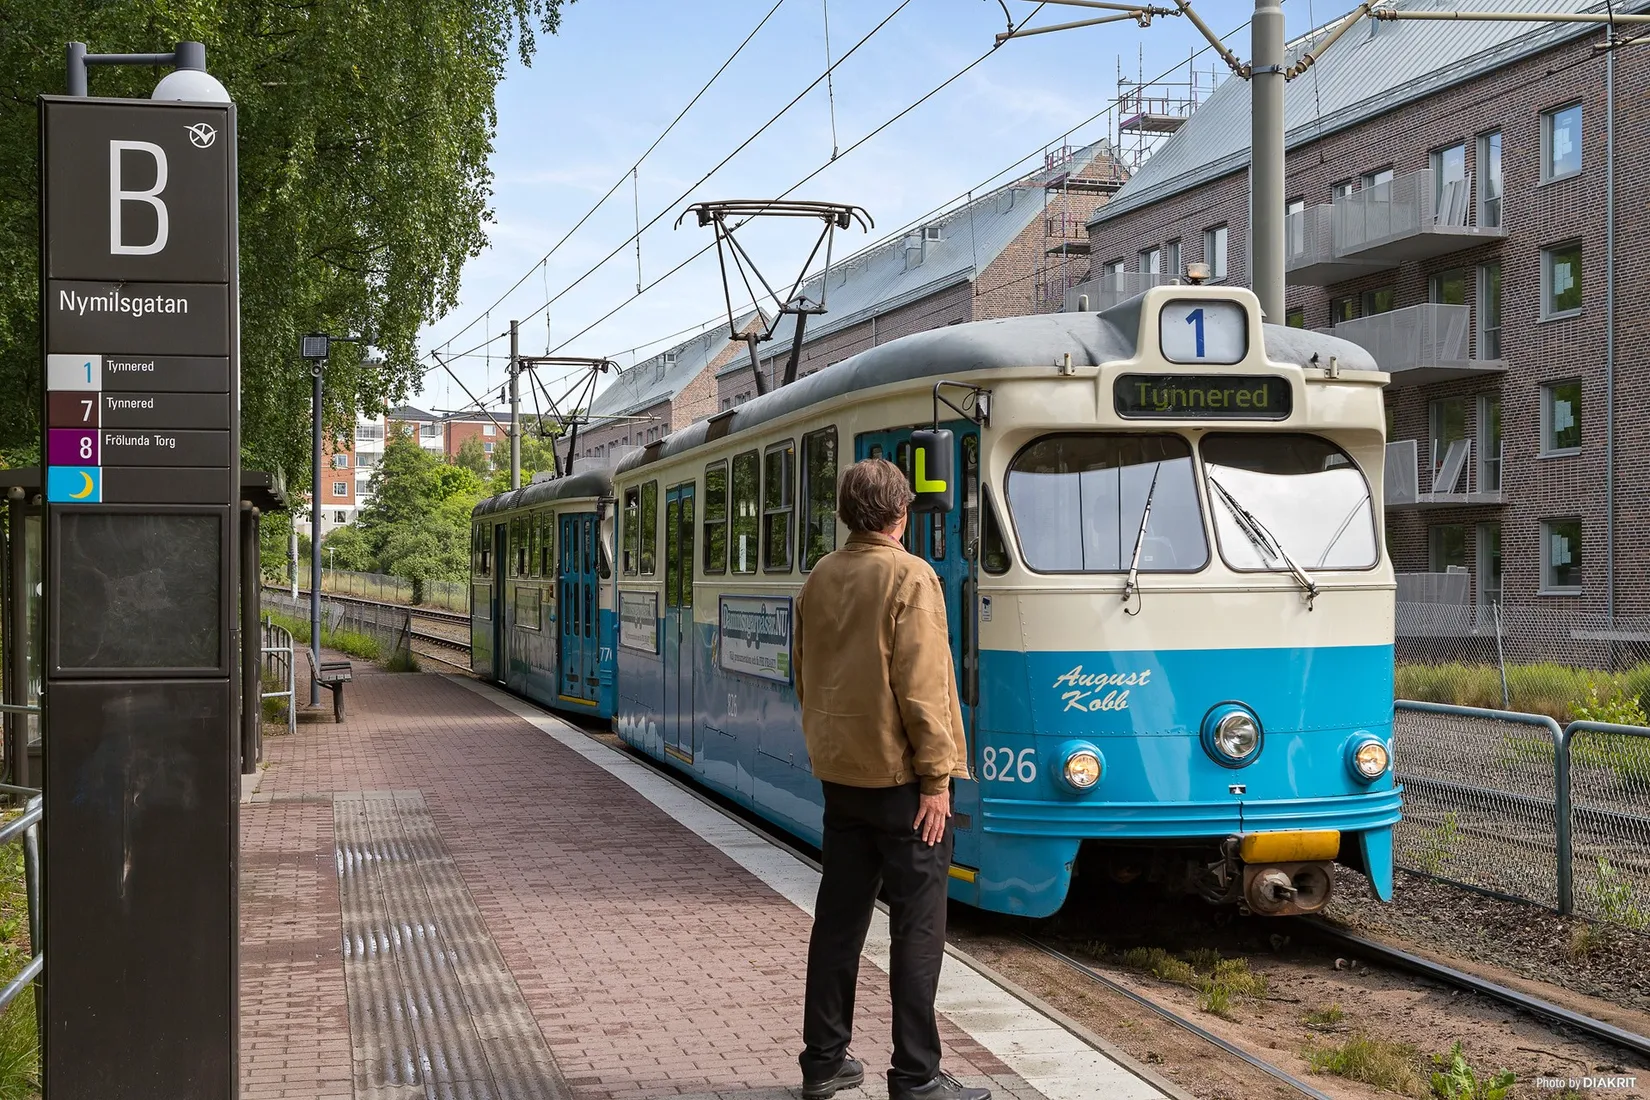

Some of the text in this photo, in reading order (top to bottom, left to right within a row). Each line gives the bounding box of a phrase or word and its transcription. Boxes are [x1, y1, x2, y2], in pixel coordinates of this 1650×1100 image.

[110, 140, 169, 255] B
[59, 290, 188, 317] Nymilsgatan
[1185, 308, 1205, 358] 1
[83, 360, 154, 383] 1 Tynnered
[81, 397, 154, 422] 7 Tynnered
[1135, 382, 1268, 411] Tynnered
[79, 434, 176, 459] 8 Frölunda Torg
[1052, 664, 1152, 693] August
[727, 693, 738, 717] 826
[1061, 689, 1130, 712] Kobb
[982, 746, 1037, 783] 826
